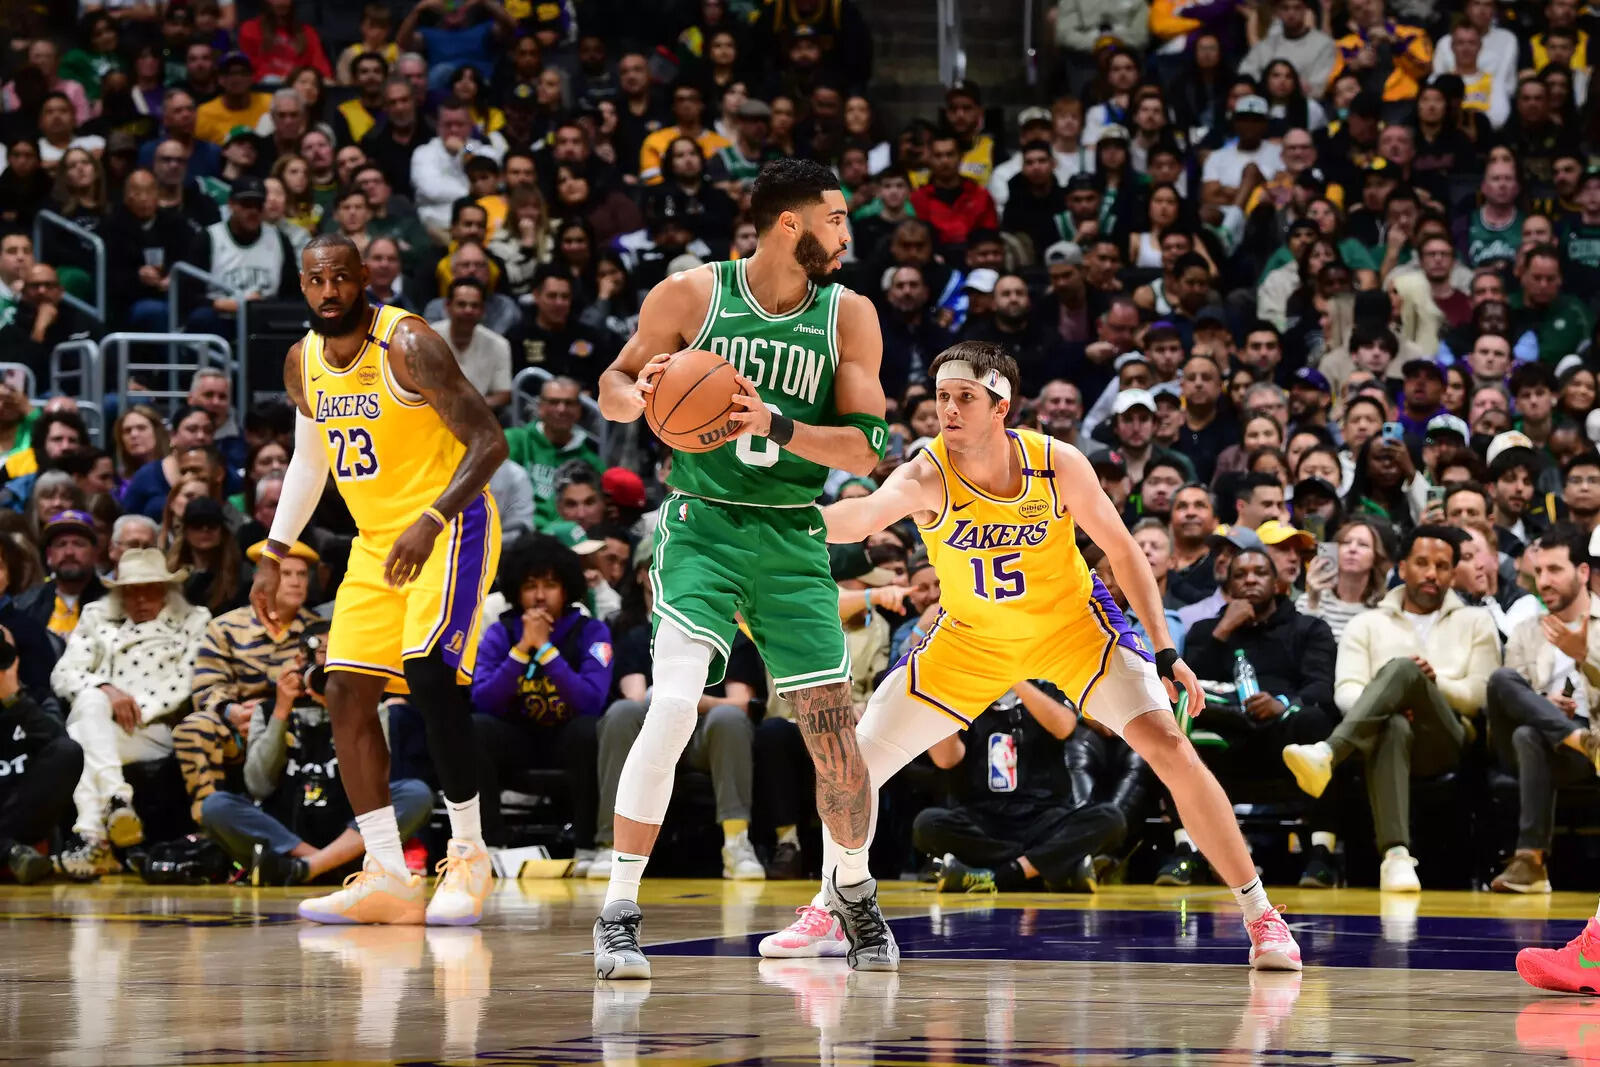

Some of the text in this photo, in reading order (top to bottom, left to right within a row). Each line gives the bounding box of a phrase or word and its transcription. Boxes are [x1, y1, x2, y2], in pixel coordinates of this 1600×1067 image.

[793, 323, 825, 336] Amica
[315, 390, 381, 423] LAKERS
[327, 427, 379, 479] 23
[1020, 503, 1048, 513] bibigo
[942, 519, 1049, 551] LAKERS
[969, 552, 1026, 600] 15
